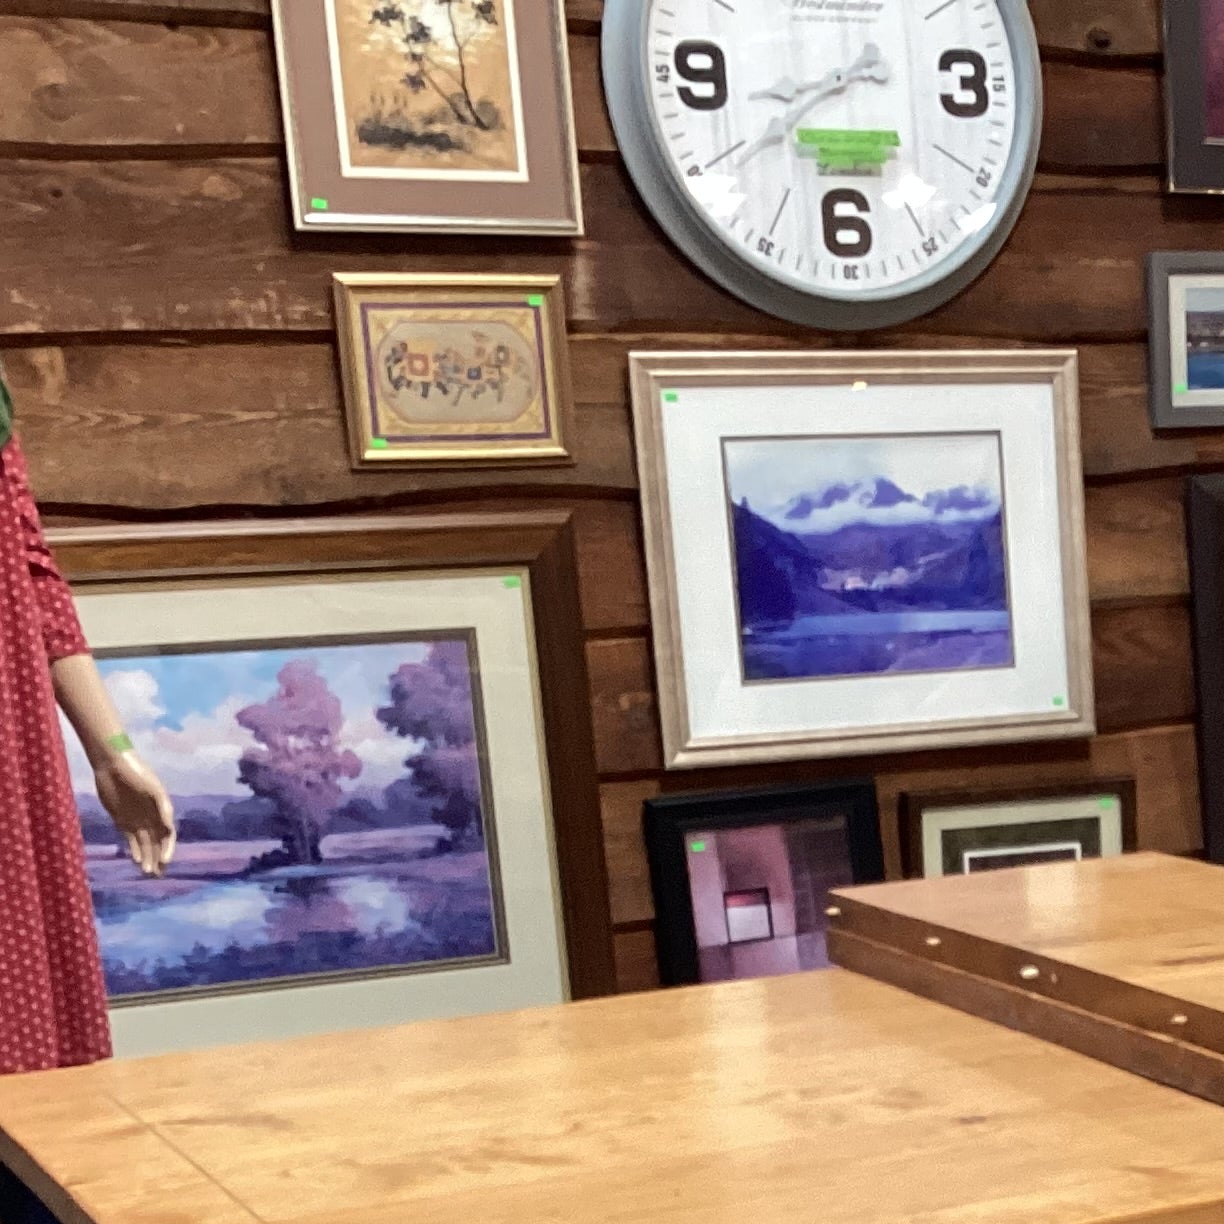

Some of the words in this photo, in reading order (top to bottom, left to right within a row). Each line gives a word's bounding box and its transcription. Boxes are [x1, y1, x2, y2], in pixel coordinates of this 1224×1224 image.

[656, 64, 670, 83] 45
[674, 40, 728, 111] 9
[938, 48, 989, 118] 3
[992, 75, 1006, 92] 15
[975, 167, 992, 188] 20
[821, 187, 873, 259] 6
[756, 237, 775, 257] 35
[922, 236, 939, 257] 25
[843, 264, 859, 281] 30
